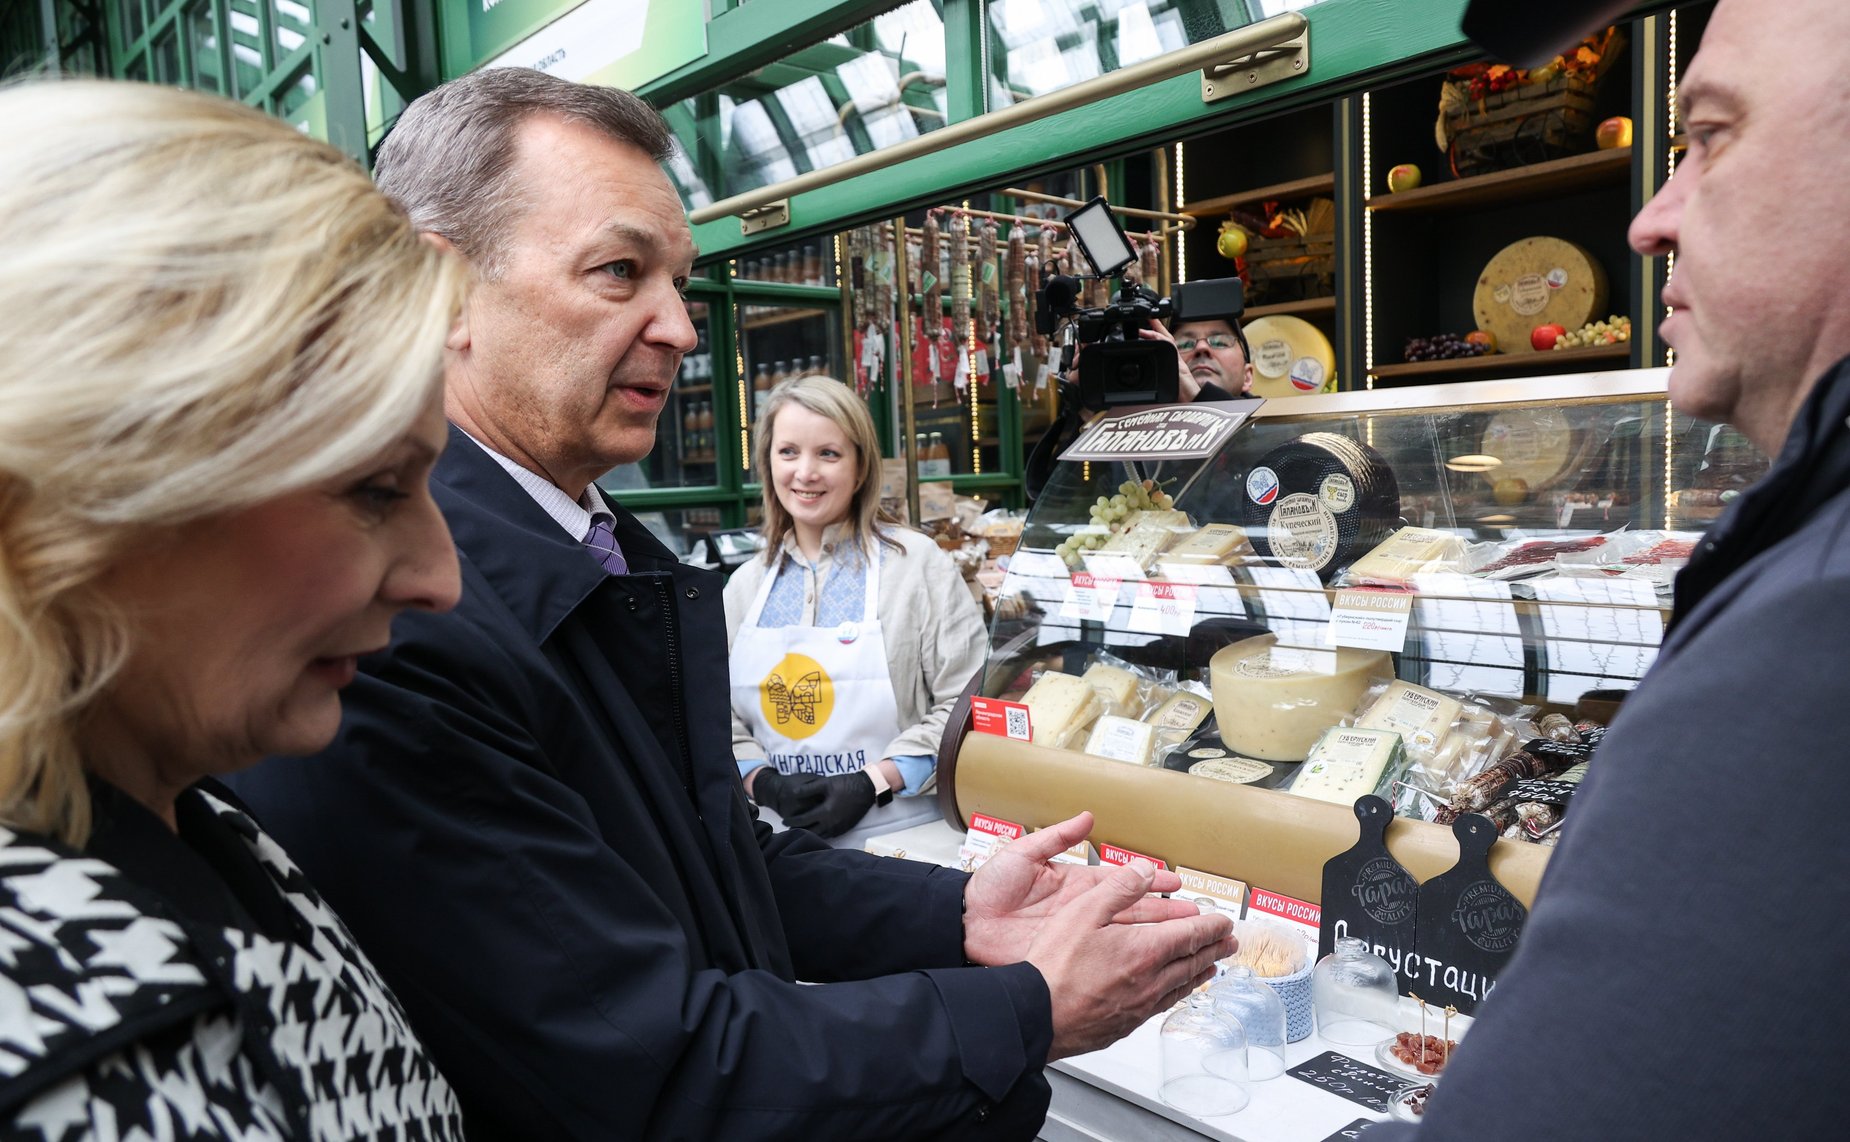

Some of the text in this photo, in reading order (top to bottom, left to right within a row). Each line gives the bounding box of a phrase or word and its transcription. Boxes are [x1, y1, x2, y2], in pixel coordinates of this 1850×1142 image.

[1118, 411, 1170, 430] СЕМЕЙНАЯ
[1280, 517, 1321, 529] Купеческий
[1339, 594, 1407, 609] ВКУСЫ РОССИИ
[973, 816, 1018, 838] ВКУСЫ РОССИИ
[1105, 848, 1129, 864] ВКУСЫ
[1362, 860, 1402, 880] PREMIUM
[1178, 873, 1205, 888] ВКУСЫ
[1206, 880, 1240, 898] РОССИИ
[1352, 874, 1416, 907] Tapas
[1464, 883, 1507, 903] PREMIUM
[1256, 893, 1286, 912] ВКУСЫ
[1286, 904, 1321, 922] РОССИИ
[1374, 902, 1412, 921] QUALITY
[1452, 901, 1525, 933] Tapas
[1477, 927, 1519, 950] QUALITY
